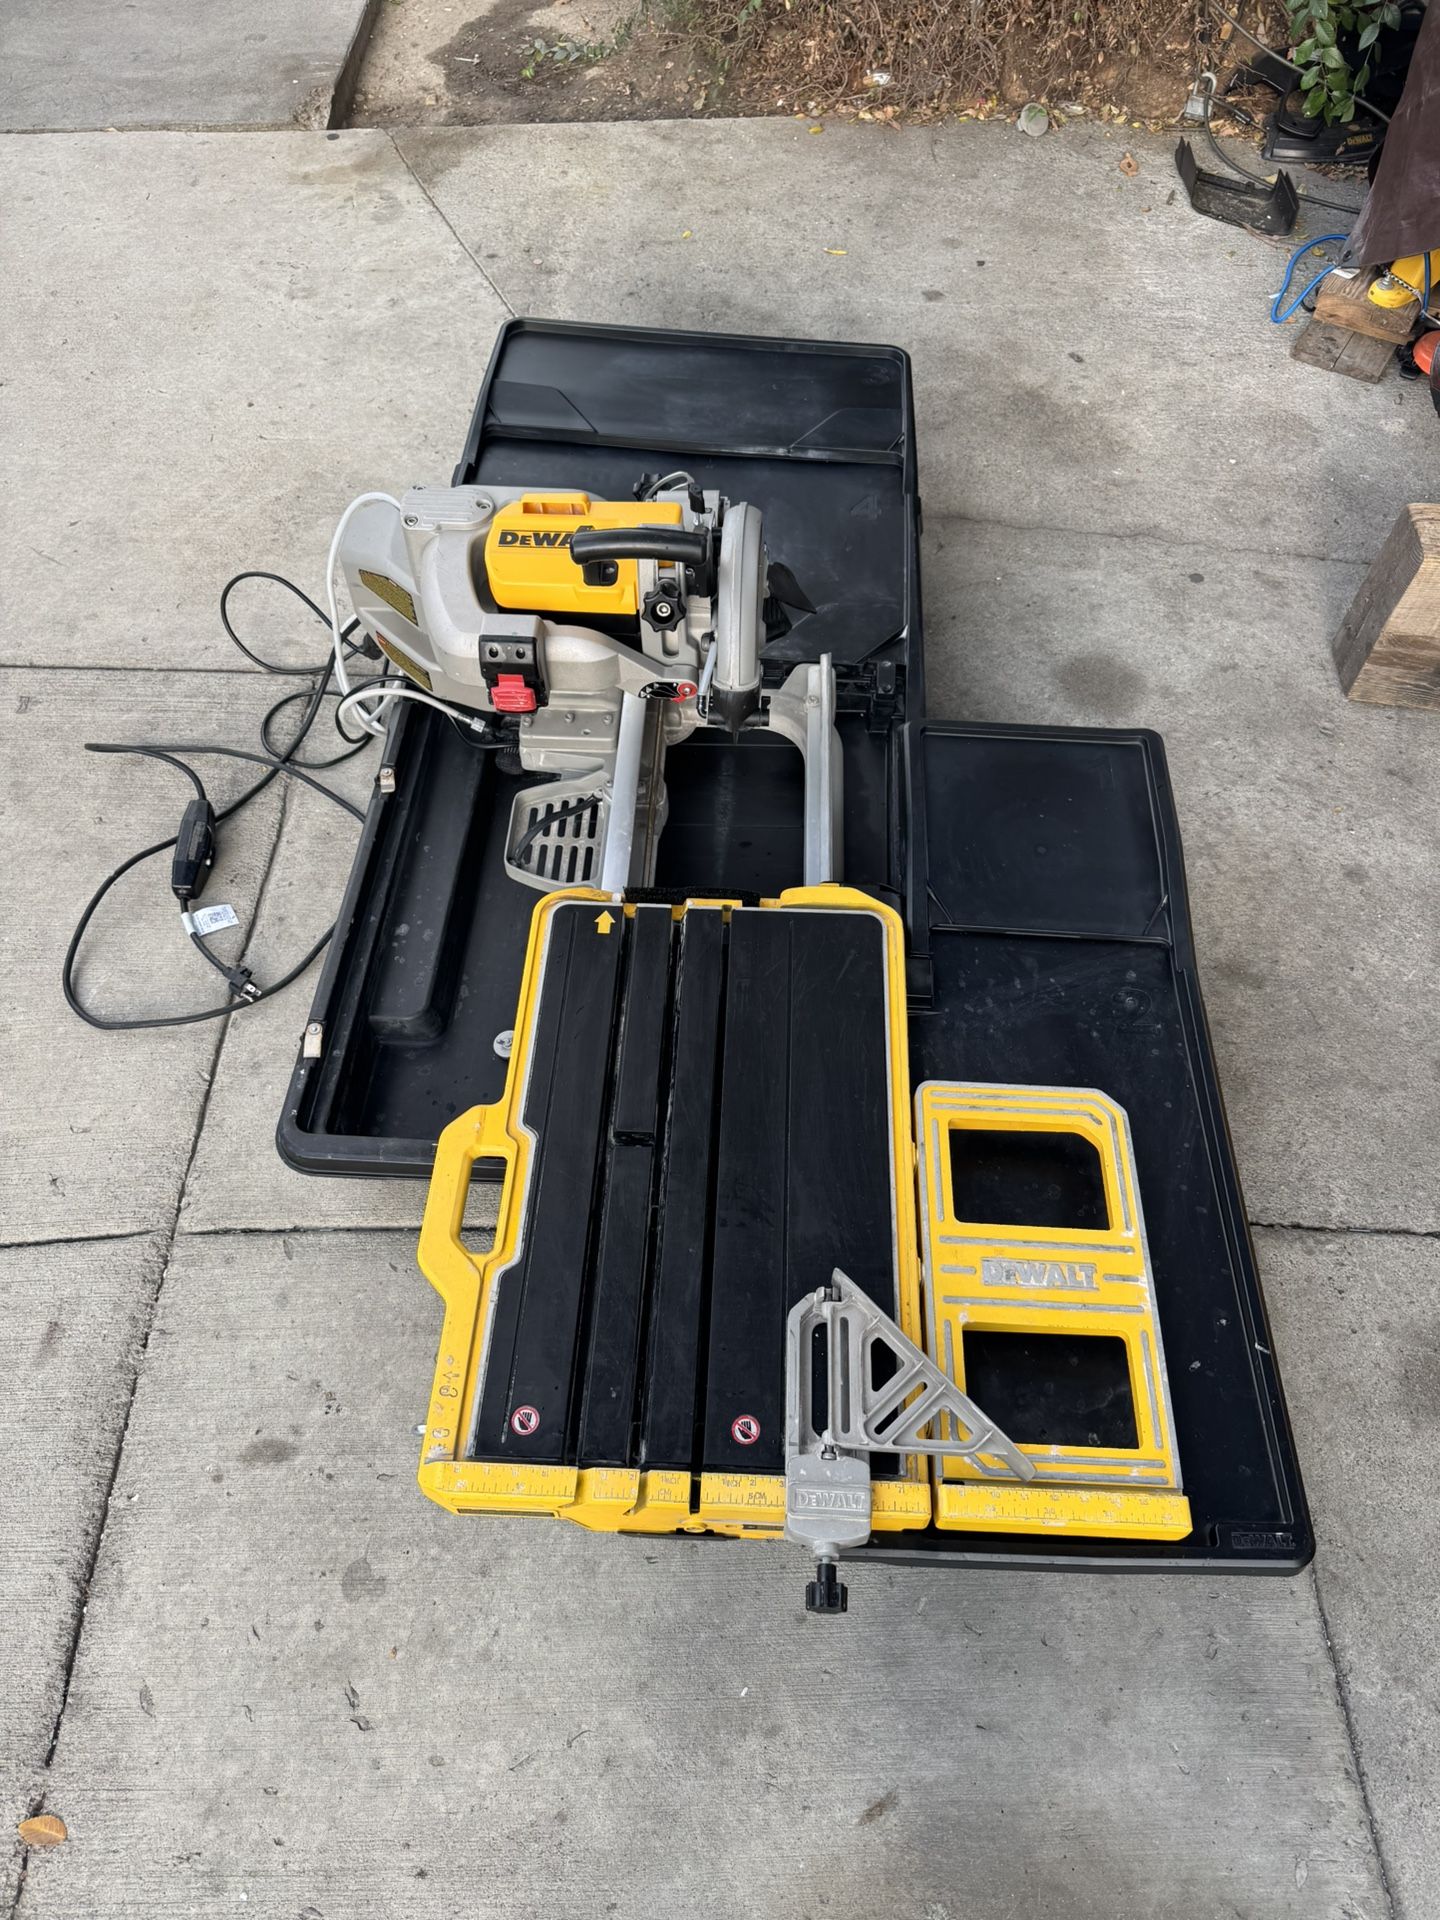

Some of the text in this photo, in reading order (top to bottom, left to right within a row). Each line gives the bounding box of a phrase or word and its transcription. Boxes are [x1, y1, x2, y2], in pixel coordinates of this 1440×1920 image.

[498, 531, 573, 546] DEWA
[982, 1260, 1097, 1289] DEWALT
[798, 1491, 865, 1509] DEWALT
